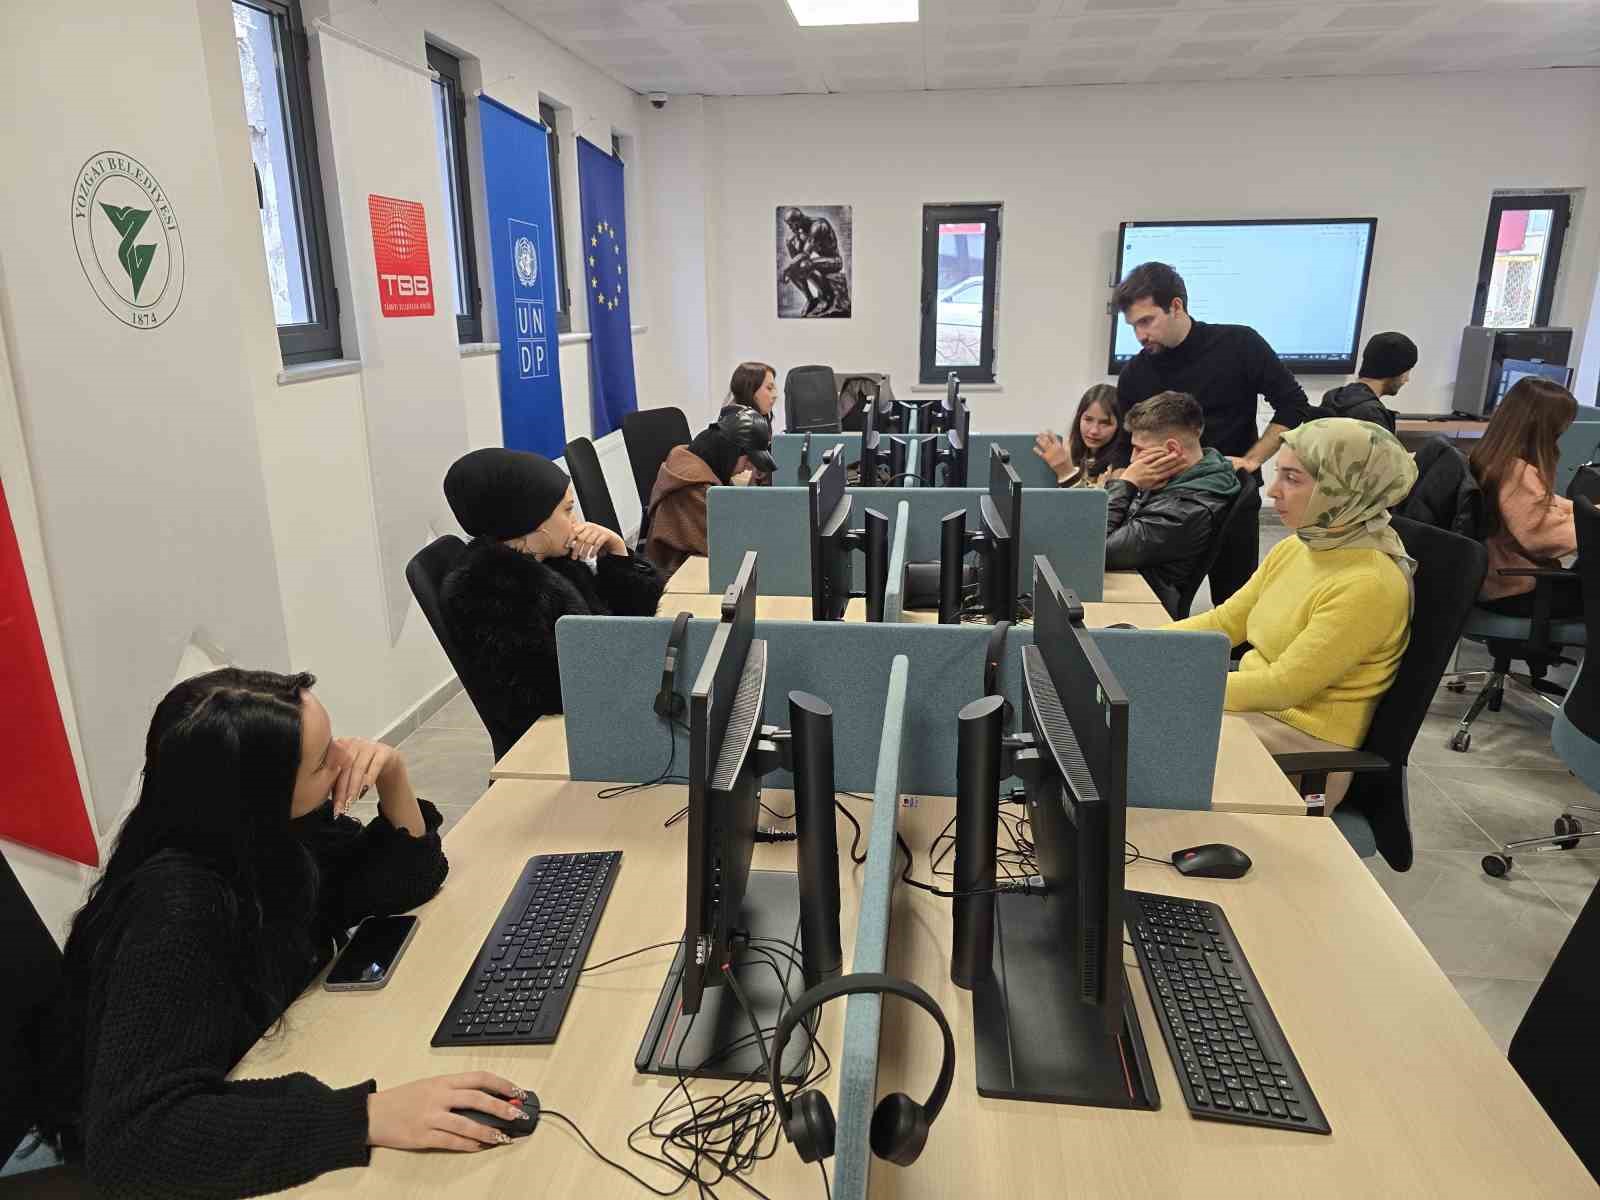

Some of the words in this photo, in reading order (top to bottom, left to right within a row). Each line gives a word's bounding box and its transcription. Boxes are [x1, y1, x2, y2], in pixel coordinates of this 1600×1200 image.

[75, 159, 105, 218] YOZGAT
[381, 274, 429, 296] TBB
[133, 312, 157, 326] 1874
[518, 307, 543, 334] UN
[521, 346, 545, 373] DP
